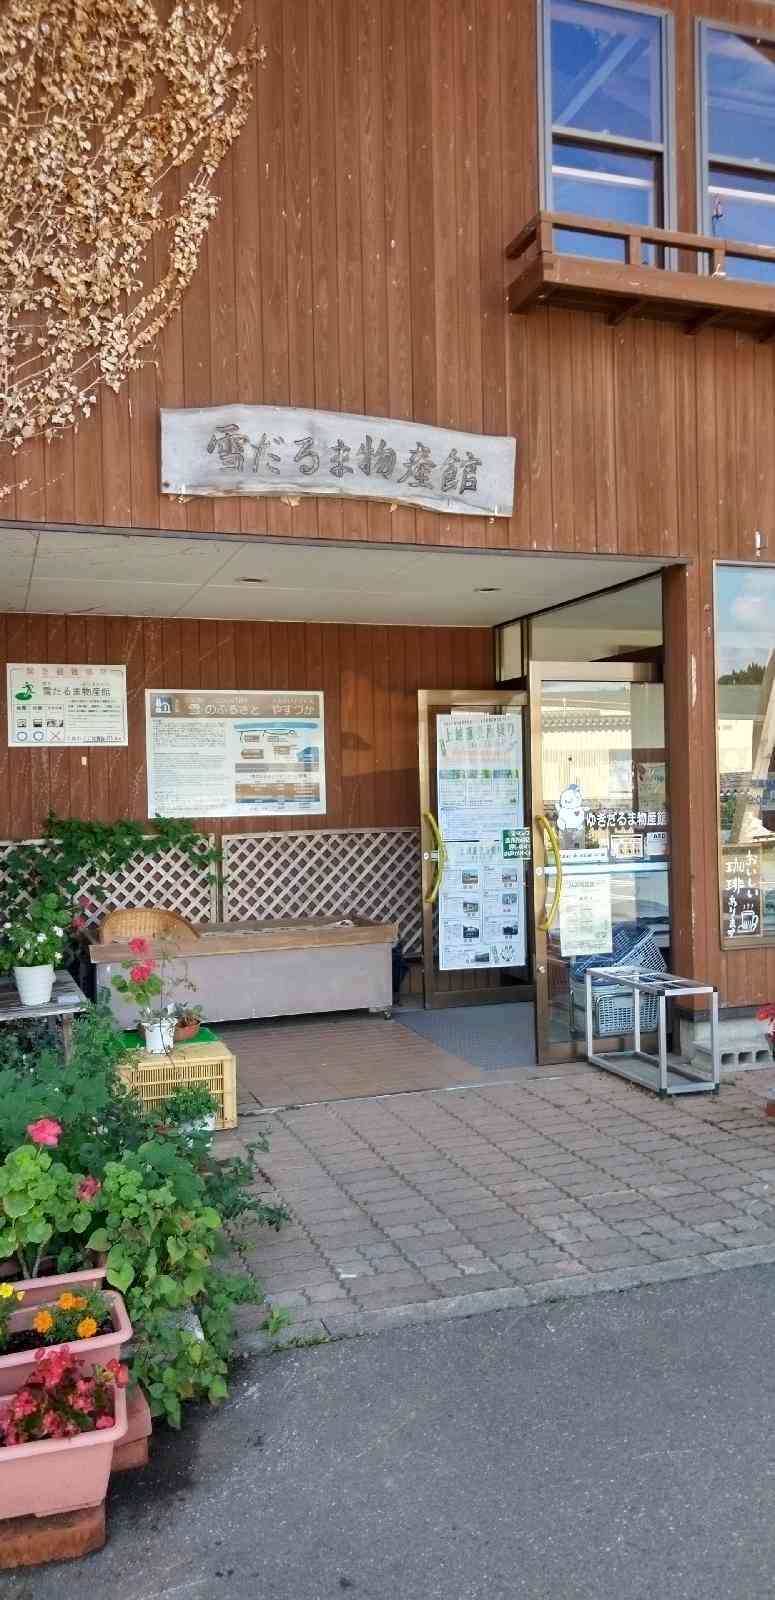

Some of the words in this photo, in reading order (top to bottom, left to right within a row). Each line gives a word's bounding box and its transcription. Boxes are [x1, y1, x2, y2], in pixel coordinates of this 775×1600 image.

[206, 423, 483, 495] 雪だるま物産館
[42, 686, 112, 698] 雪だるま物産館
[586, 810, 669, 827] ゆきだるま物産館
[725, 856, 745, 895] 珈琲
[745, 849, 759, 898] おいしい
